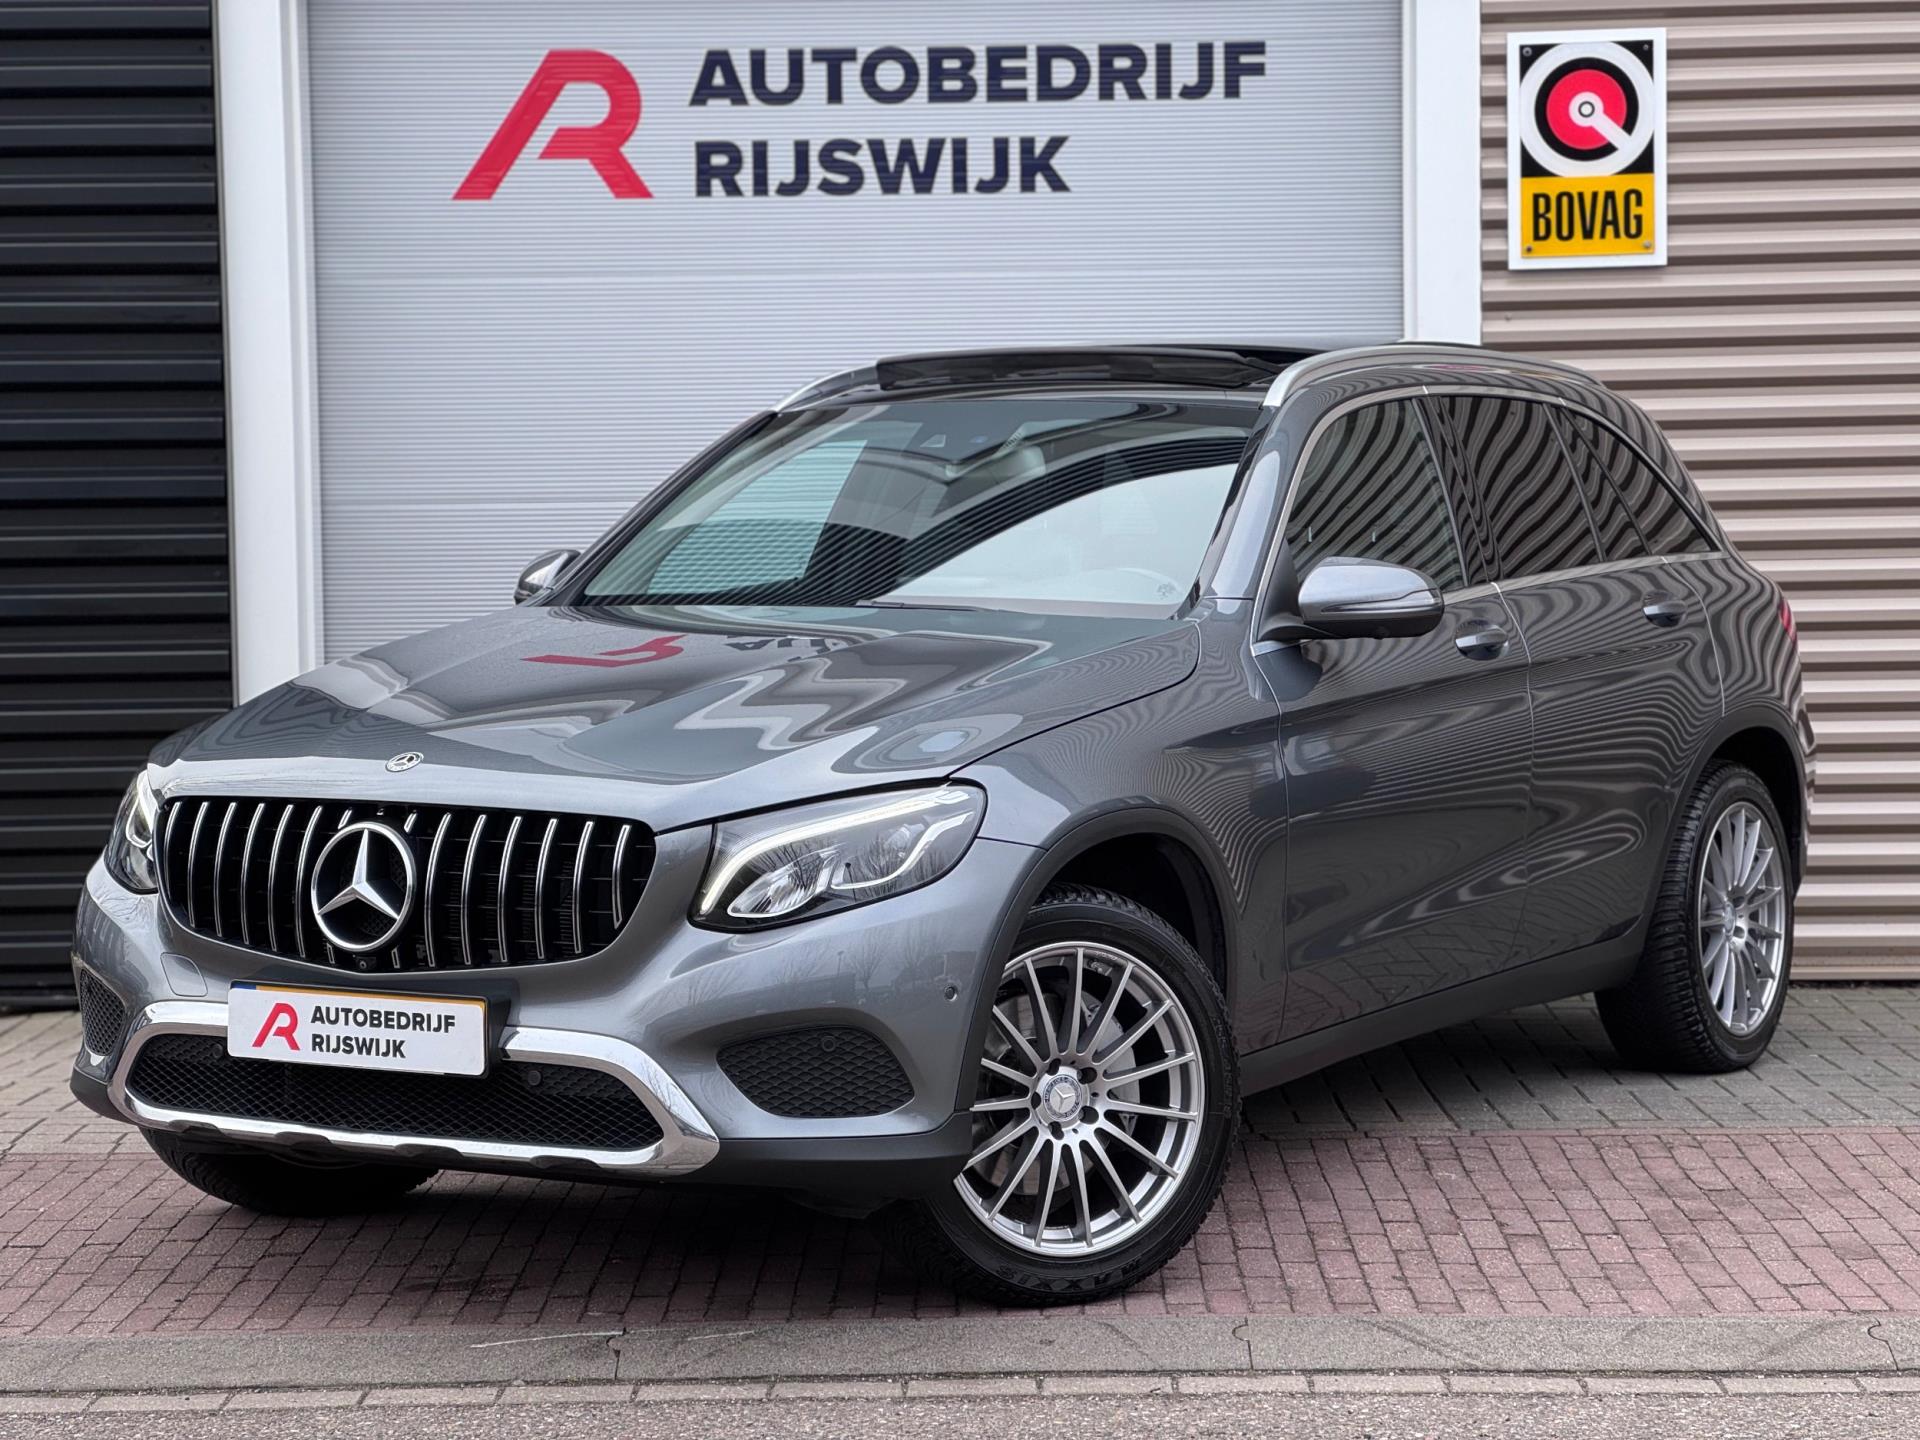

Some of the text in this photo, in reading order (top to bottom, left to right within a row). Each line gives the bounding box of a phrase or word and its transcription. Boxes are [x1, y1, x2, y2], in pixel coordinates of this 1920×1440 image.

[688, 41, 1267, 107] AUTOBEDRIJF
[694, 135, 1072, 198] RIJSWIJK
[1532, 187, 1644, 242] BOVAG
[310, 1005, 456, 1034] AUTOBEDRIJF
[310, 1033, 406, 1059] RIJSWIJK
